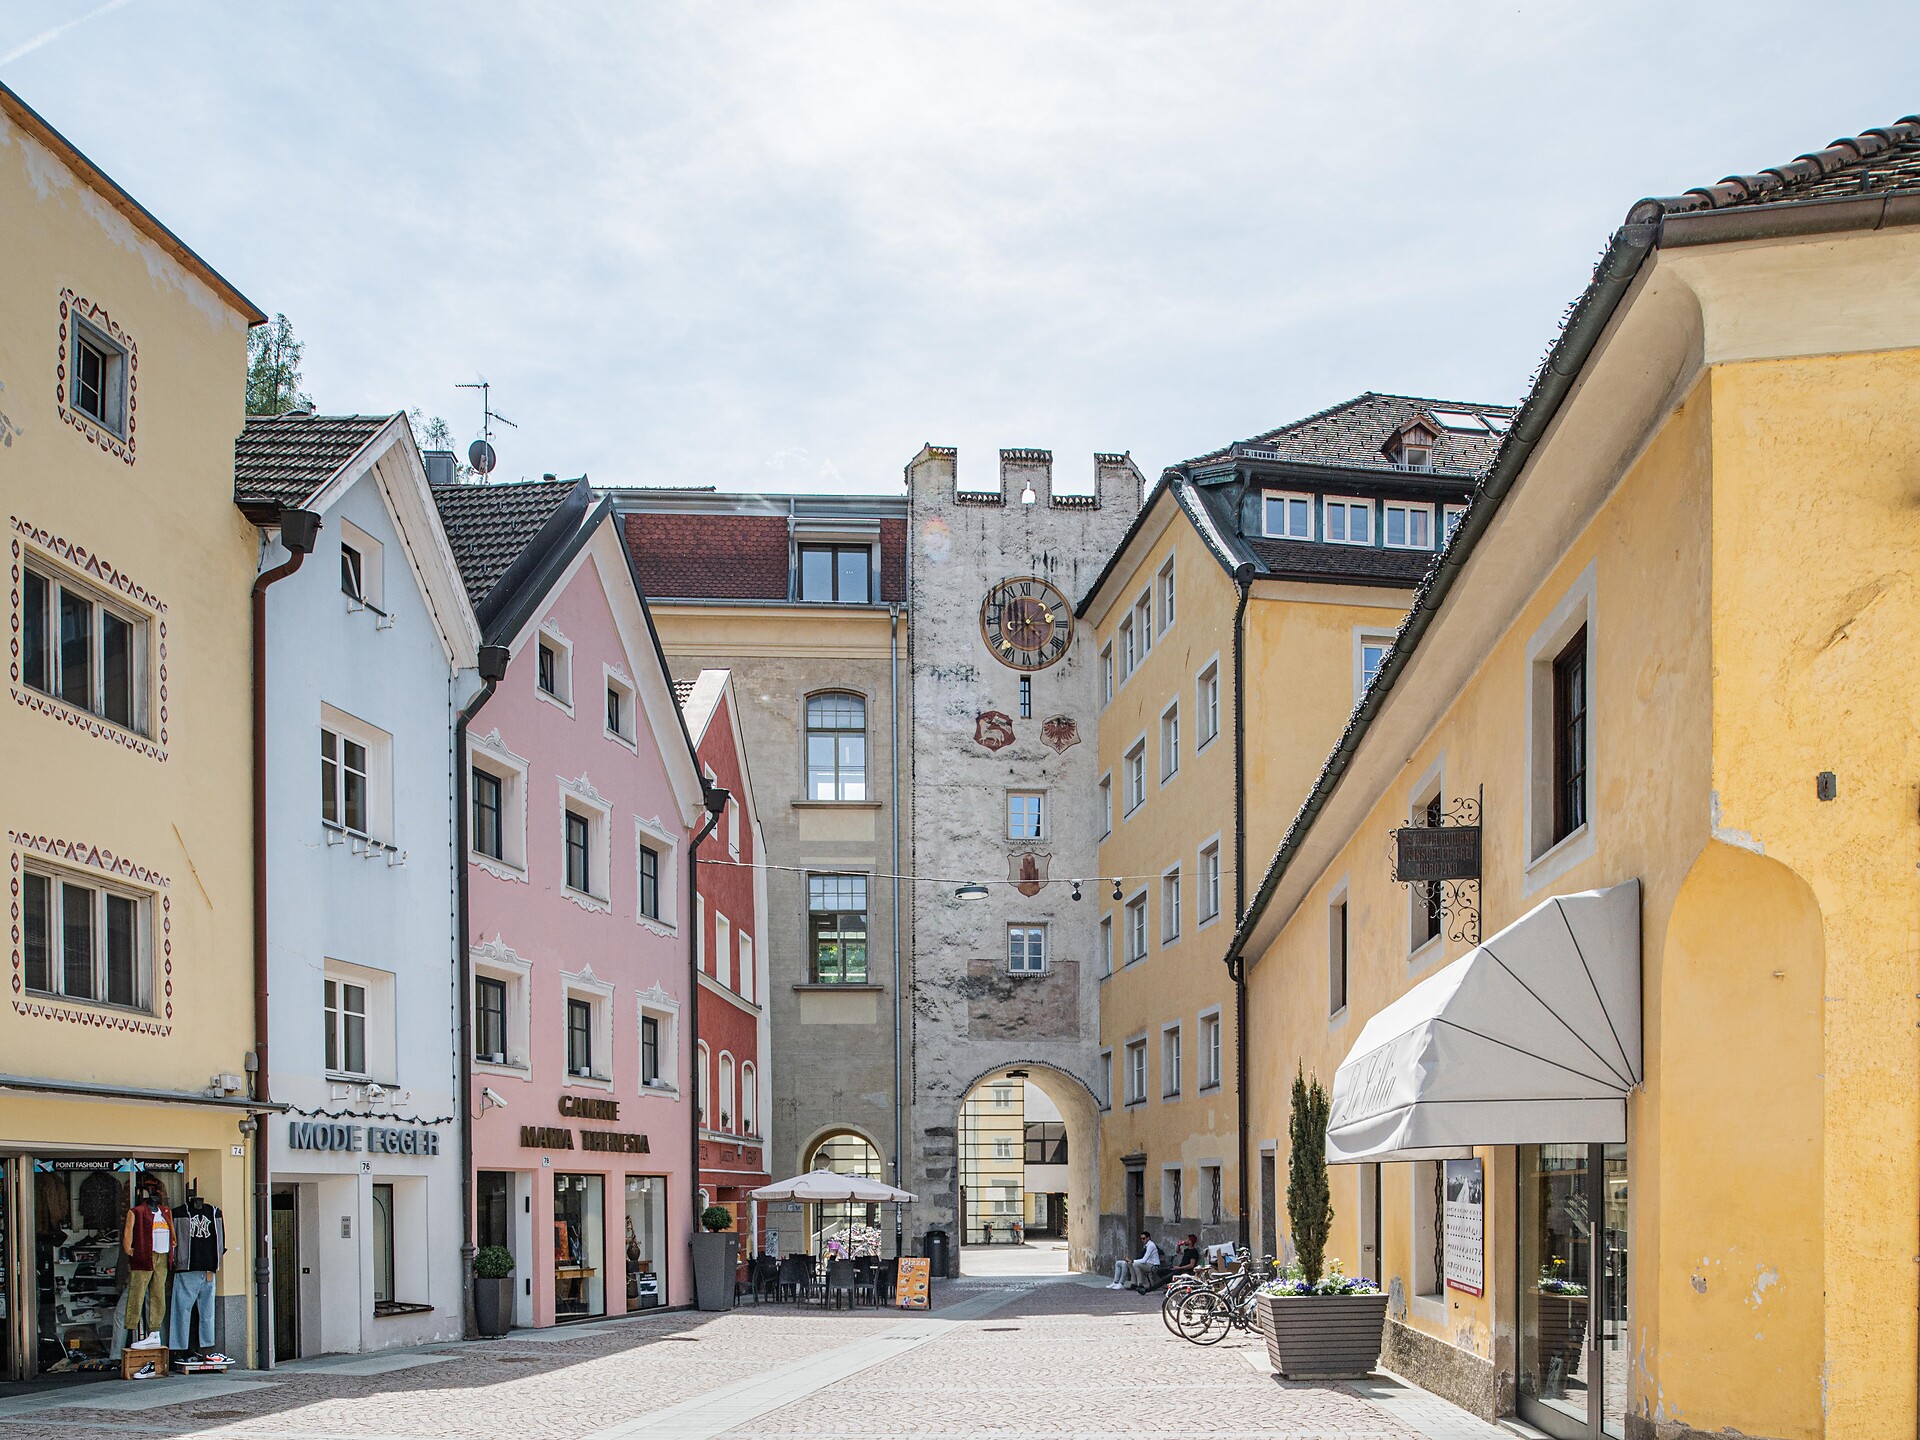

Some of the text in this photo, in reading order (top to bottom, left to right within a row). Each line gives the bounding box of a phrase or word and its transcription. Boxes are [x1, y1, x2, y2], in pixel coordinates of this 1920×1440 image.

[1019, 582, 1031, 596] XII
[289, 1121, 440, 1156] MODE EGGER
[579, 1130, 651, 1154] THERESIA
[233, 1147, 243, 1156] 74
[55, 1161, 75, 1169] POINT
[362, 1162, 371, 1171] 76
[901, 1258, 926, 1267] Pizza
